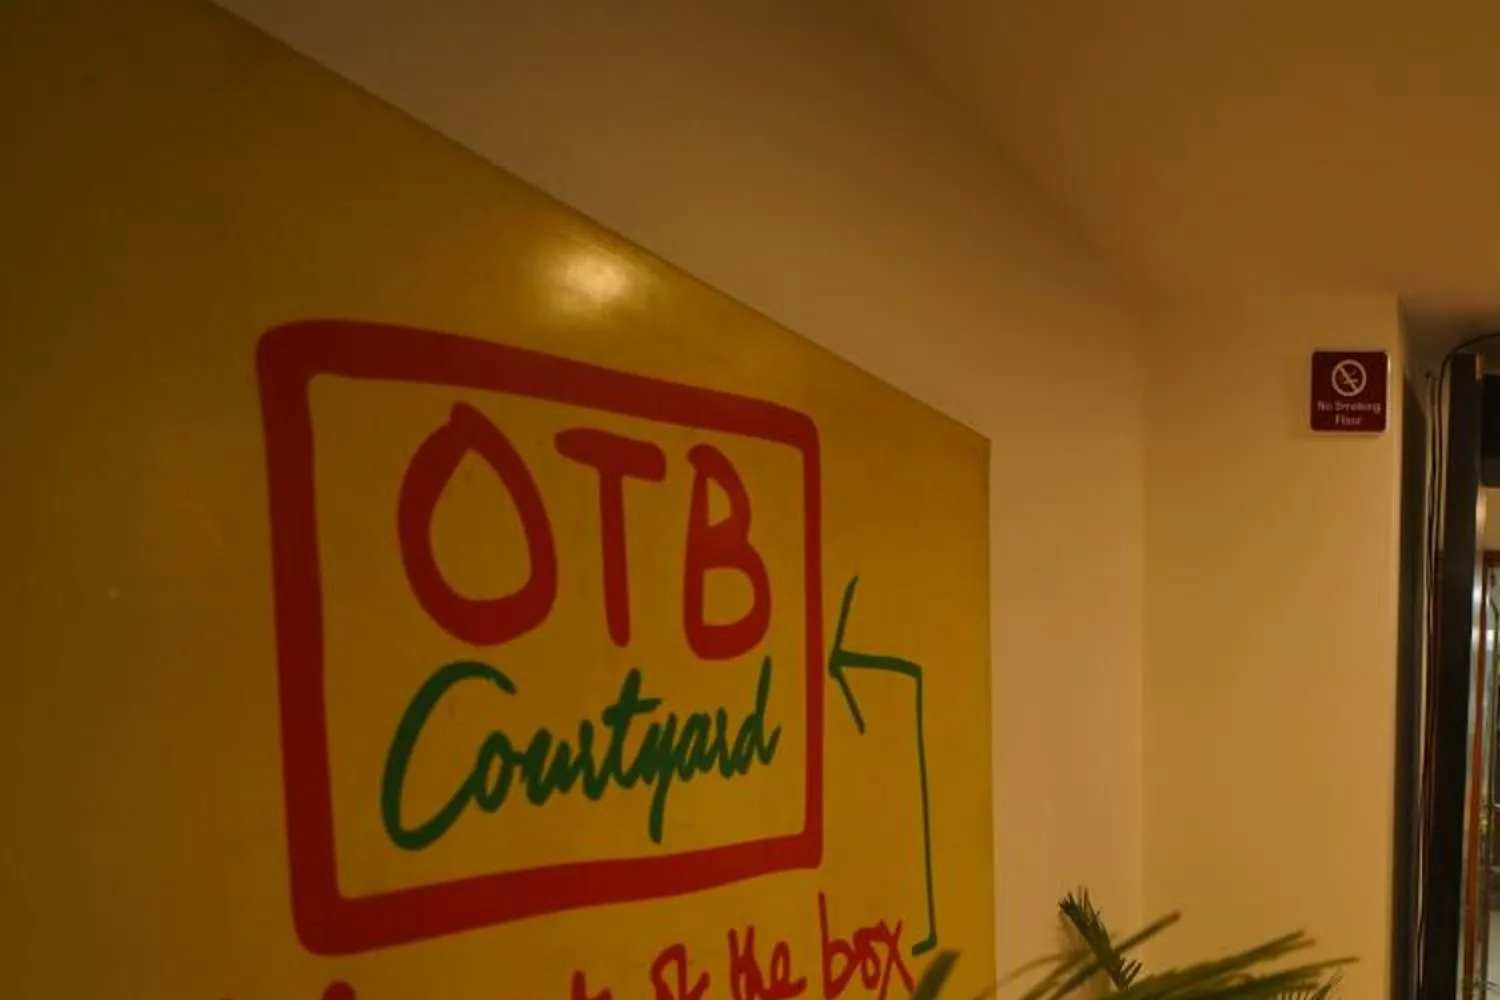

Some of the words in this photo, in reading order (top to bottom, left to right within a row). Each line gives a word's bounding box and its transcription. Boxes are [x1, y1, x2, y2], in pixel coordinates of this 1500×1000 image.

[1316, 400, 1333, 412] No
[1334, 401, 1382, 415] Smoking
[397, 400, 772, 661] OTB
[380, 656, 781, 850] Courtyard
